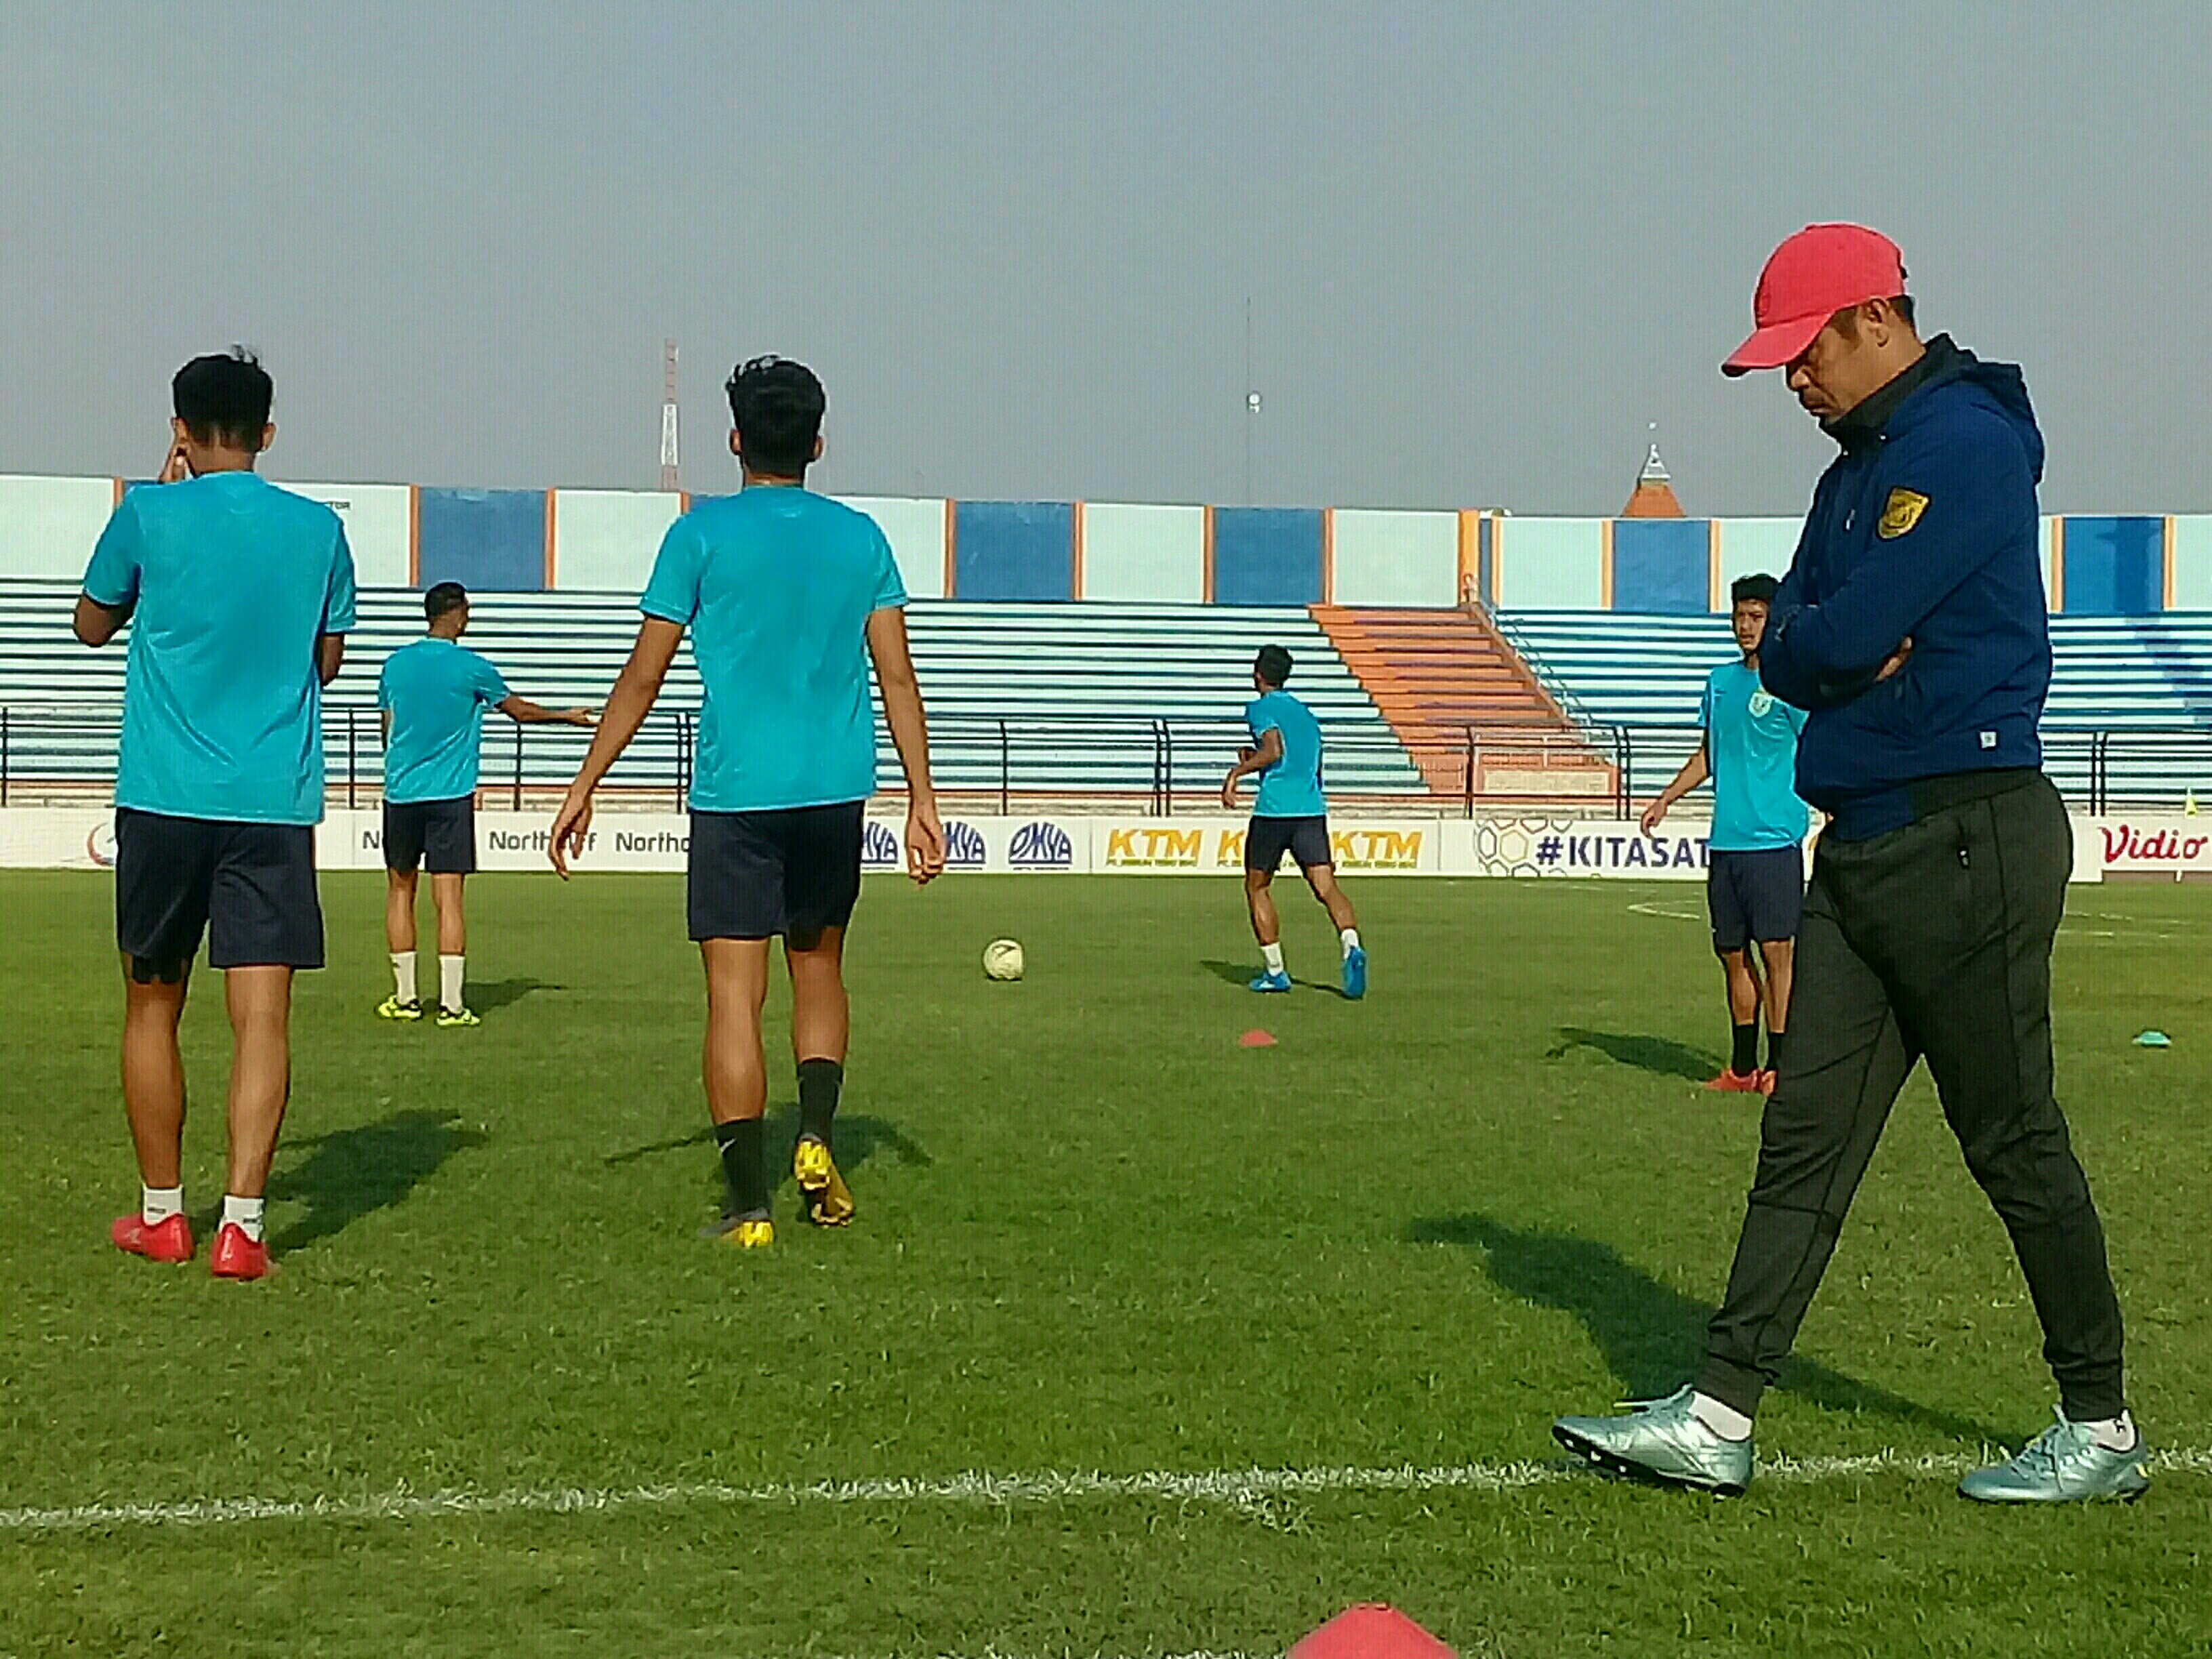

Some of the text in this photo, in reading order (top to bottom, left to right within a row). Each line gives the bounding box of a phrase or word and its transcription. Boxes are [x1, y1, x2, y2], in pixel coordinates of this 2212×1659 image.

[1108, 829, 1203, 858] KTM
[1331, 831, 1422, 860] KTM
[1536, 836, 1710, 868] #KITASAT
[2097, 824, 2209, 863] Vidio
